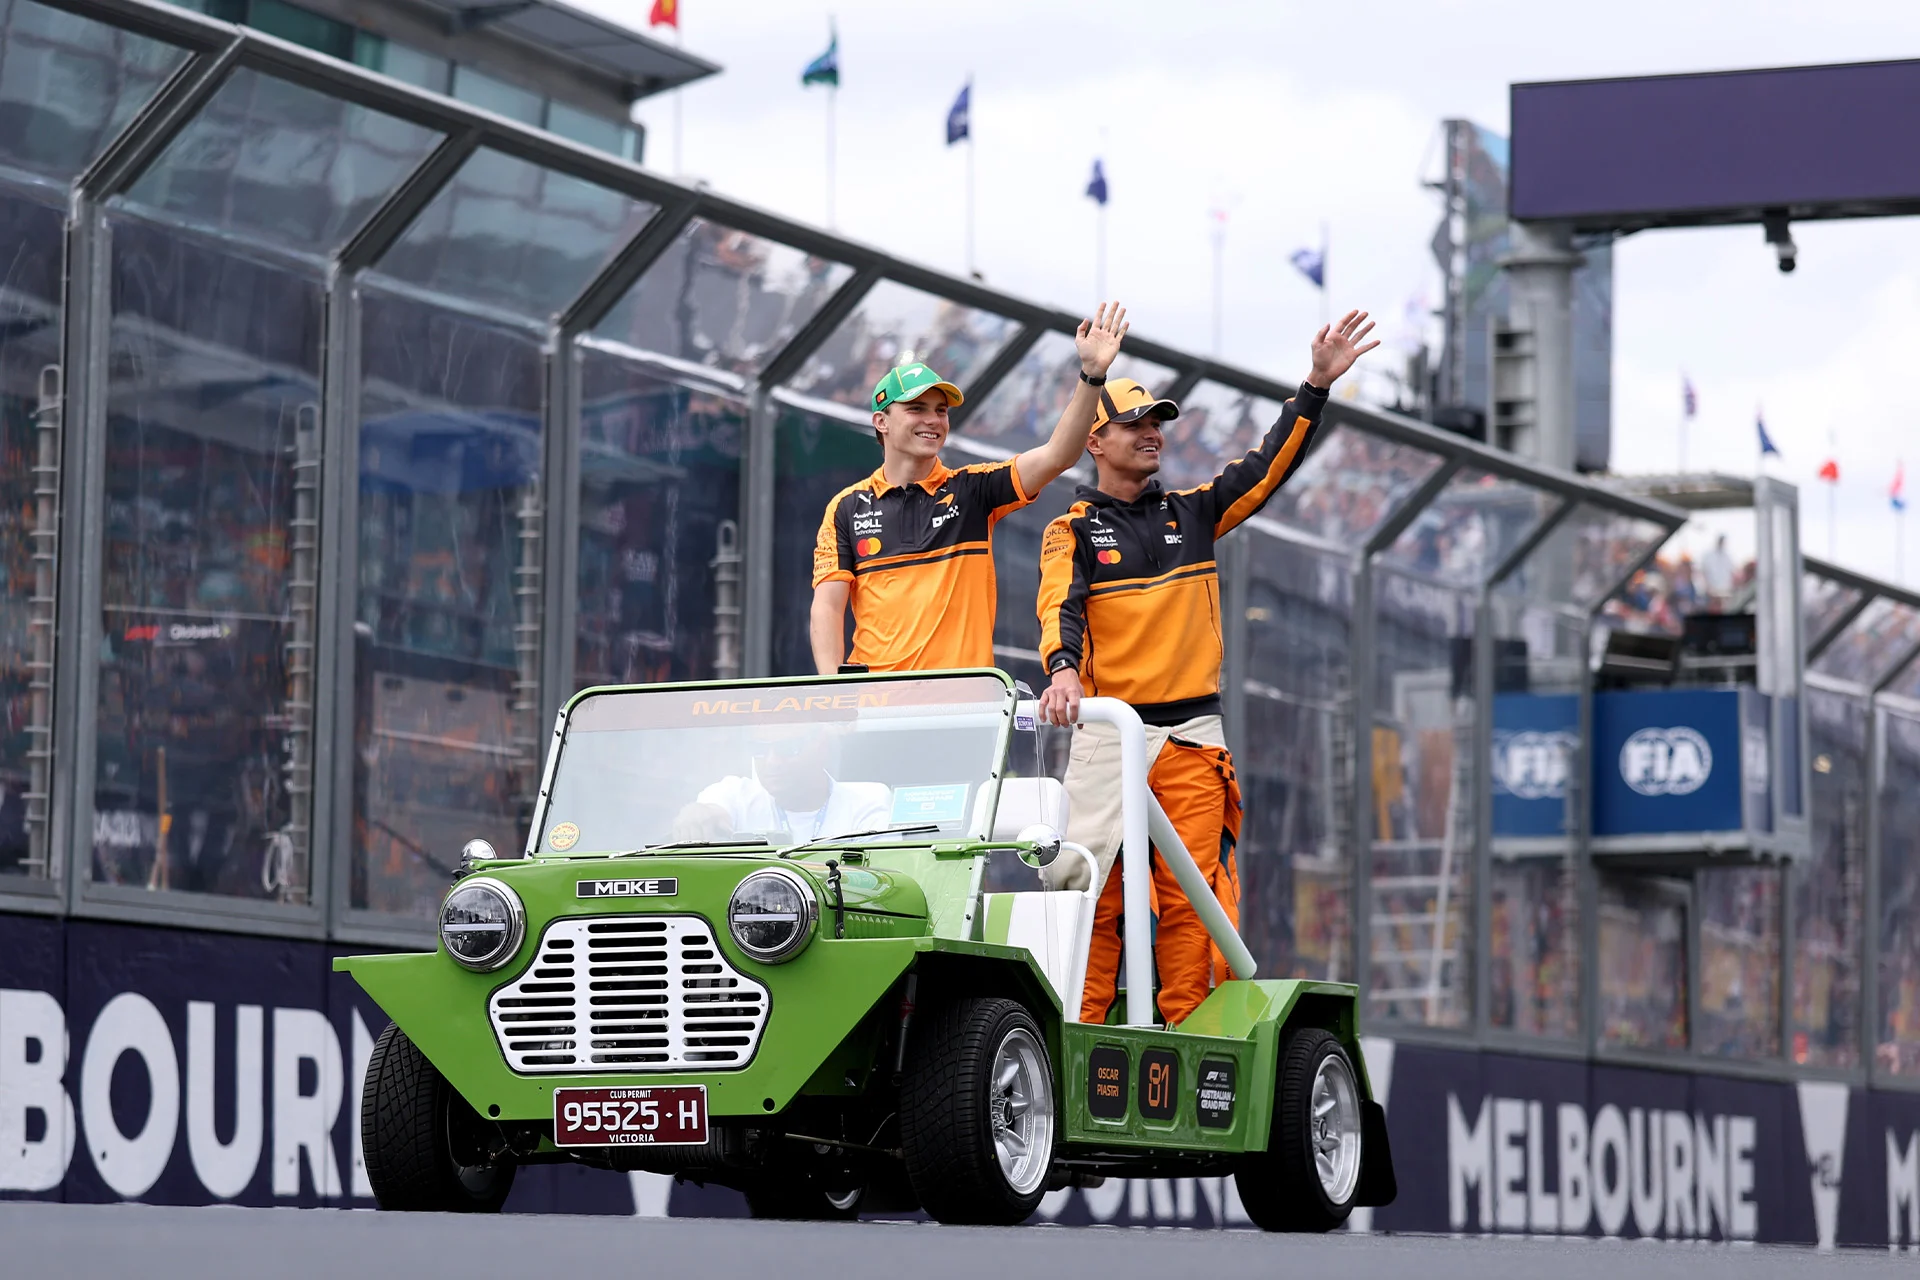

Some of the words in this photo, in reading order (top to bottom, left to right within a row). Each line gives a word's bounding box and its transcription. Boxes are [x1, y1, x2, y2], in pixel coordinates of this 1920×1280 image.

[853, 518, 882, 531] DELL
[1045, 526, 1070, 539] okta
[1091, 535, 1117, 544] DELL
[1625, 739, 1702, 787] FIA
[595, 880, 659, 895] MOKE
[1097, 1067, 1119, 1081] OSCAR
[1096, 1083, 1119, 1097] PIASTRI
[1148, 1062, 1169, 1109] 81
[609, 1090, 626, 1099] CLUB
[627, 1089, 652, 1099] PERMIT
[1200, 1088, 1232, 1101] AUSTRALIAN
[1201, 1099, 1218, 1110] GRAND
[1218, 1100, 1230, 1111] PRIX
[608, 1133, 655, 1143] VICTORIA
[1447, 1090, 1758, 1240] MELBOURNE
